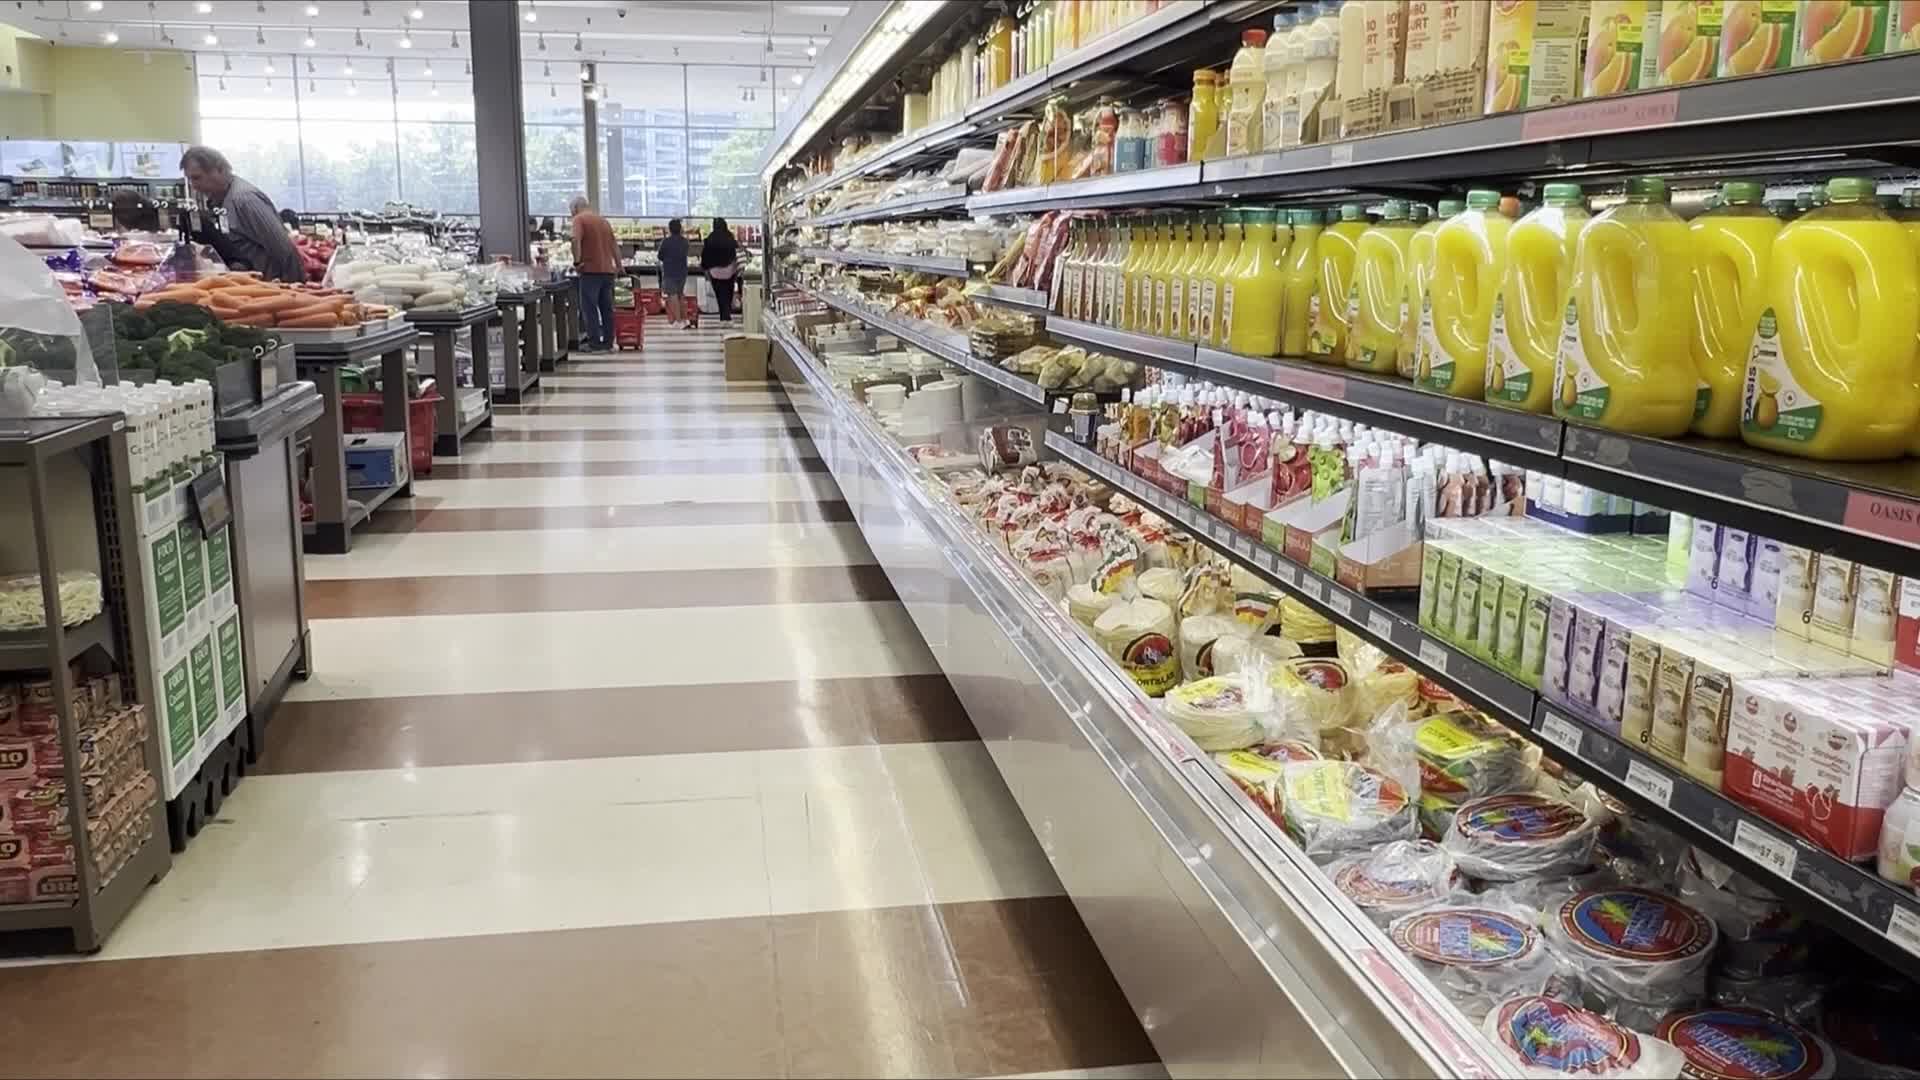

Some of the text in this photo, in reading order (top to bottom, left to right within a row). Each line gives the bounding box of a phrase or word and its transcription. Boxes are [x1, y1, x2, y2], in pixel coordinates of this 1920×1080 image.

[1870, 502, 1914, 522] OASIS
[1801, 610, 1812, 624] 6
[1640, 730, 1649, 743] 6
[1759, 844, 1786, 867] $7.99
